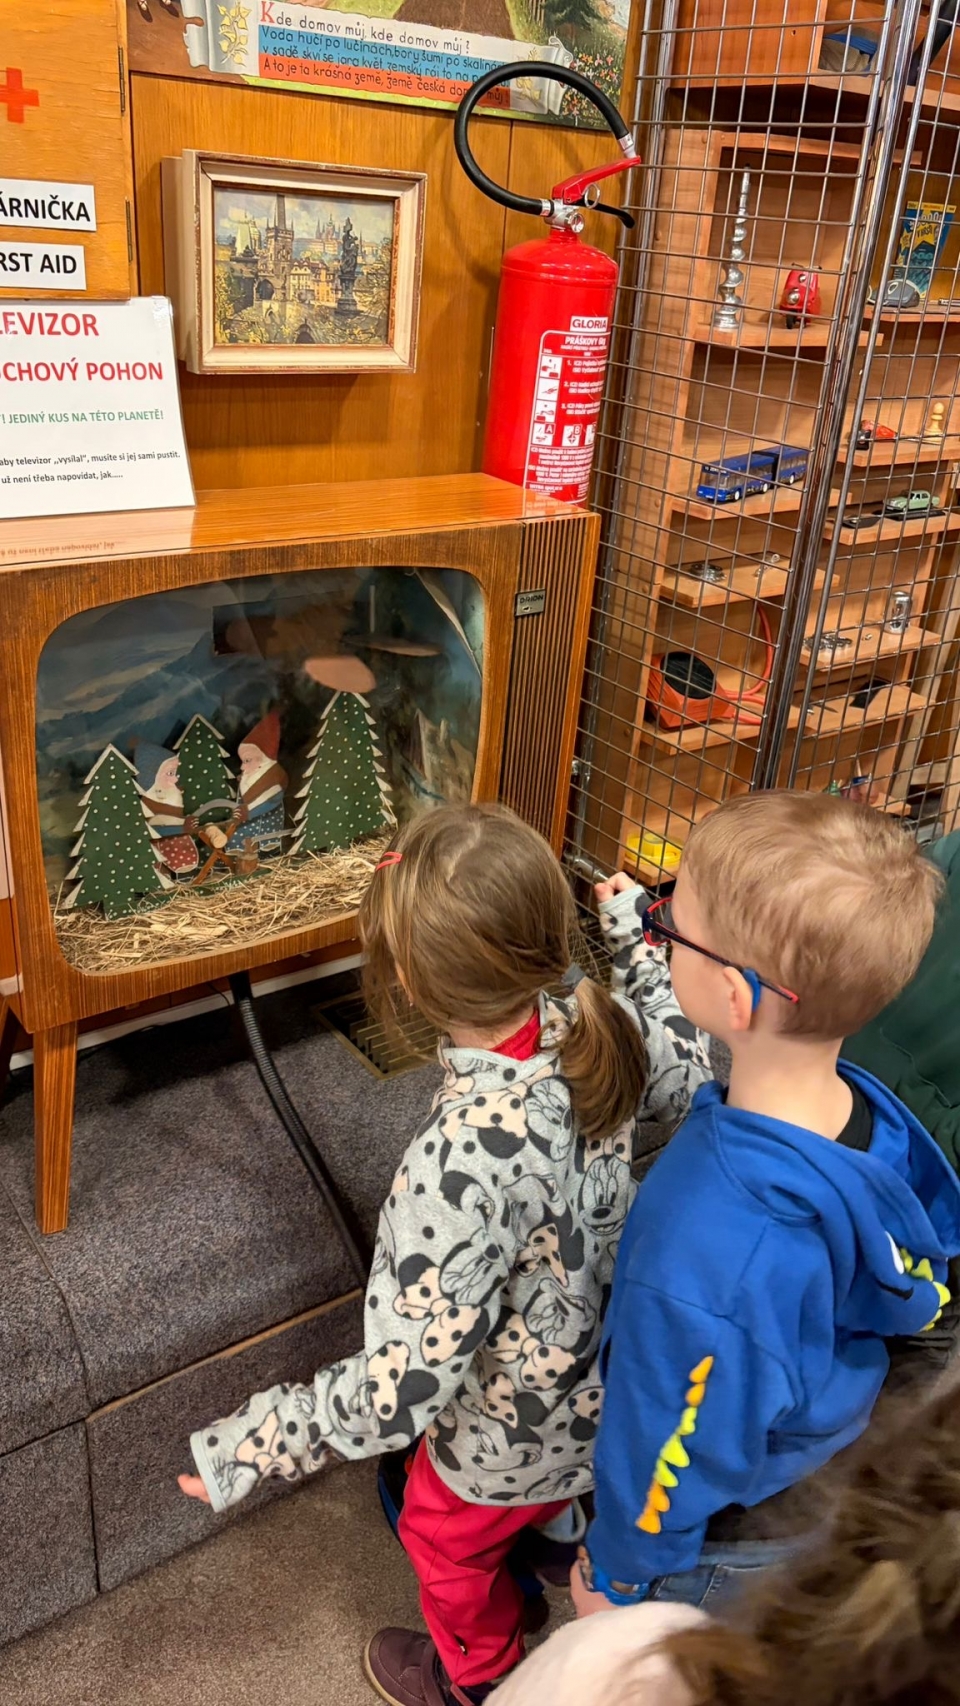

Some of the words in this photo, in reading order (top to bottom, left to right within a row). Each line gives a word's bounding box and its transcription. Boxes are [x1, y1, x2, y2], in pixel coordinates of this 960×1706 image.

[260, 1, 292, 26] Kde
[299, 16, 341, 33] domov
[371, 26, 393, 42] kde
[399, 31, 439, 48] domov
[261, 25, 293, 42] Voda
[298, 30, 323, 46] hučí
[325, 38, 341, 50] po
[421, 49, 444, 63] šumí
[445, 56, 460, 68] po
[262, 46, 269, 54] v
[272, 45, 299, 58] sadě
[323, 53, 334, 63] se
[335, 53, 359, 68] jara
[387, 61, 422, 77] zemský
[442, 66, 452, 80] to
[455, 72, 469, 82] na
[263, 58, 271, 71] A
[273, 60, 284, 73] to
[286, 61, 297, 76] je
[299, 63, 310, 75] ta
[313, 64, 351, 80] krásná
[355, 71, 384, 87] země,
[387, 76, 413, 90] země
[417, 77, 446, 93] česká
[40, 254, 77, 274] AID
[0, 311, 100, 336] EVIZOR
[572, 318, 606, 329] GLORIA
[0, 357, 79, 381] CHOVÝ
[86, 362, 163, 381] POHON
[9, 411, 45, 424] JEDINÝ
[48, 412, 70, 423] KUS
[71, 412, 88, 422] NA
[89, 410, 115, 421] TÉTO
[118, 408, 164, 421] PLANETĚ!
[0, 457, 14, 467] aby
[15, 456, 51, 466] televizor
[119, 452, 125, 461] si
[126, 452, 137, 462] jej
[137, 451, 156, 460] sami
[157, 450, 181, 460] pustit.
[1, 475, 12, 484] už
[13, 474, 31, 483] není
[33, 473, 55, 482] třeba
[520, 594, 544, 604] ORION
